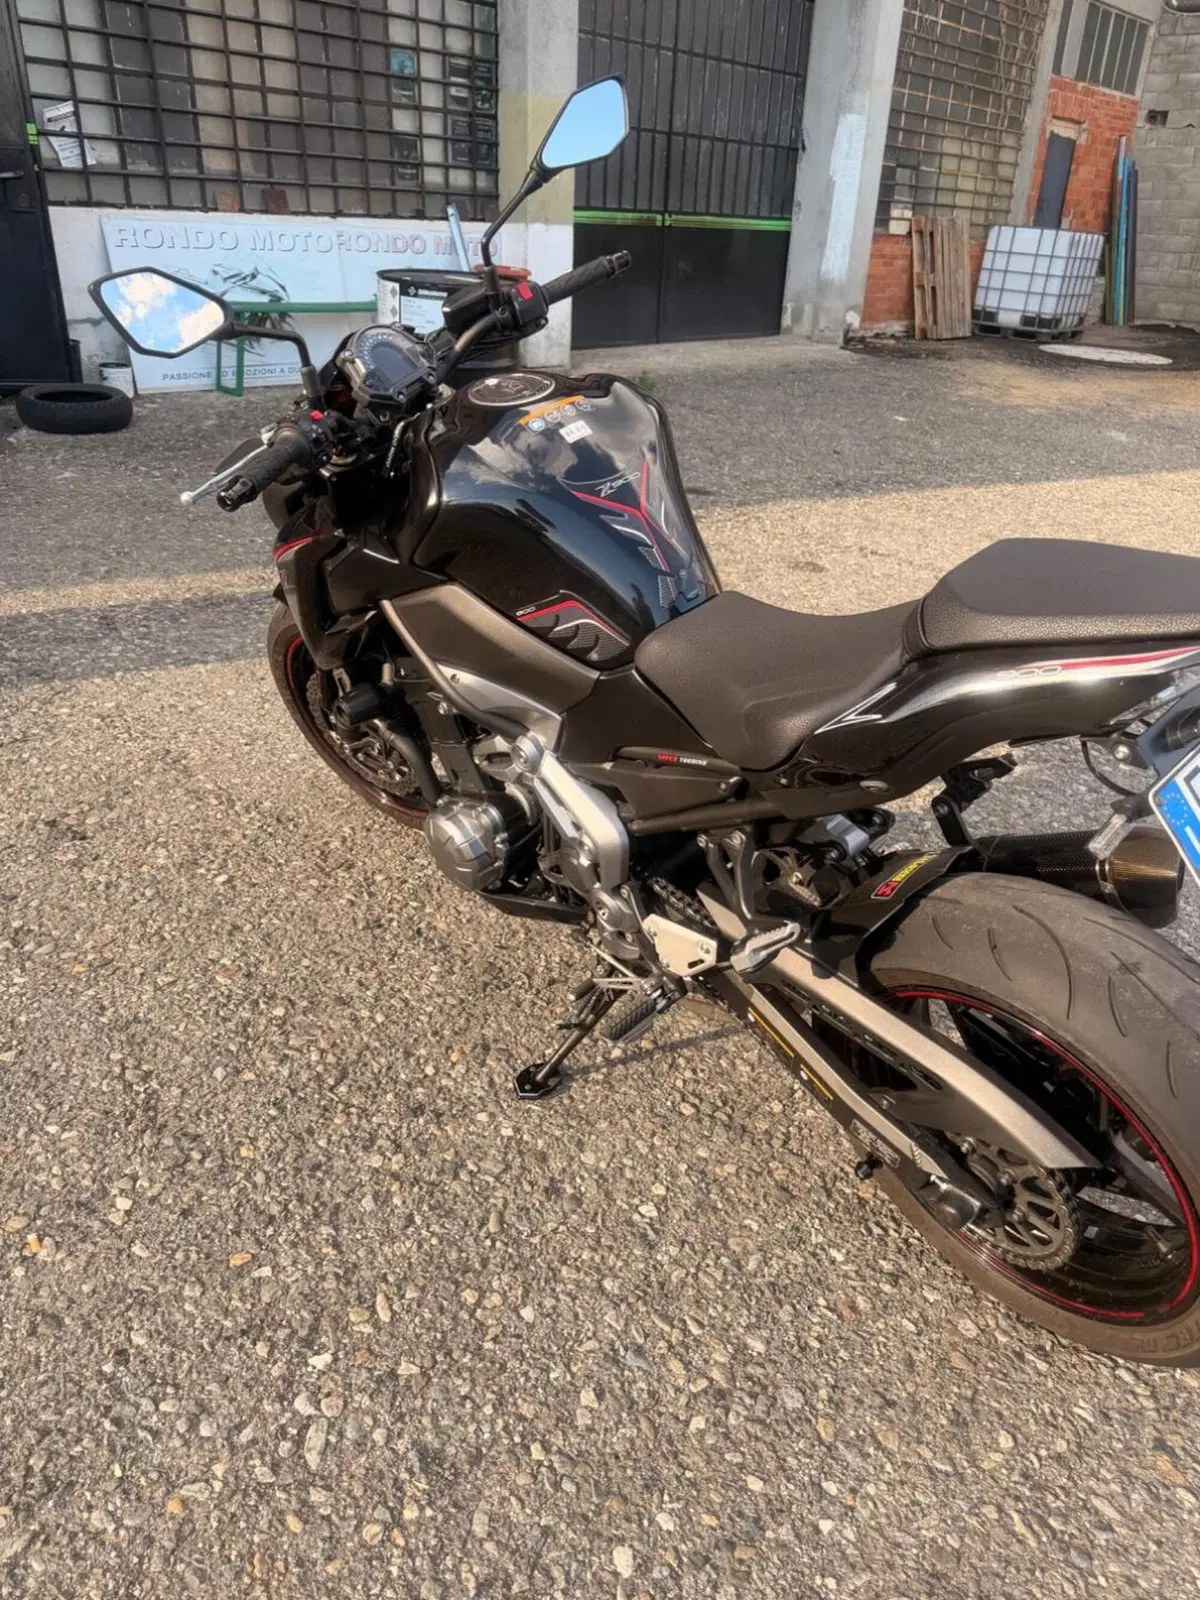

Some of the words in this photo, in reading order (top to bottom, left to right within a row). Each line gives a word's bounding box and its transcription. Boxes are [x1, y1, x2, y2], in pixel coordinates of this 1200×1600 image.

[114, 226, 240, 251] RONDO
[249, 229, 334, 254] MOTO
[336, 230, 427, 255] RONDO
[162, 370, 213, 381] PASSIONE
[231, 367, 277, 378] EOZIONI
[593, 471, 641, 498] Z900
